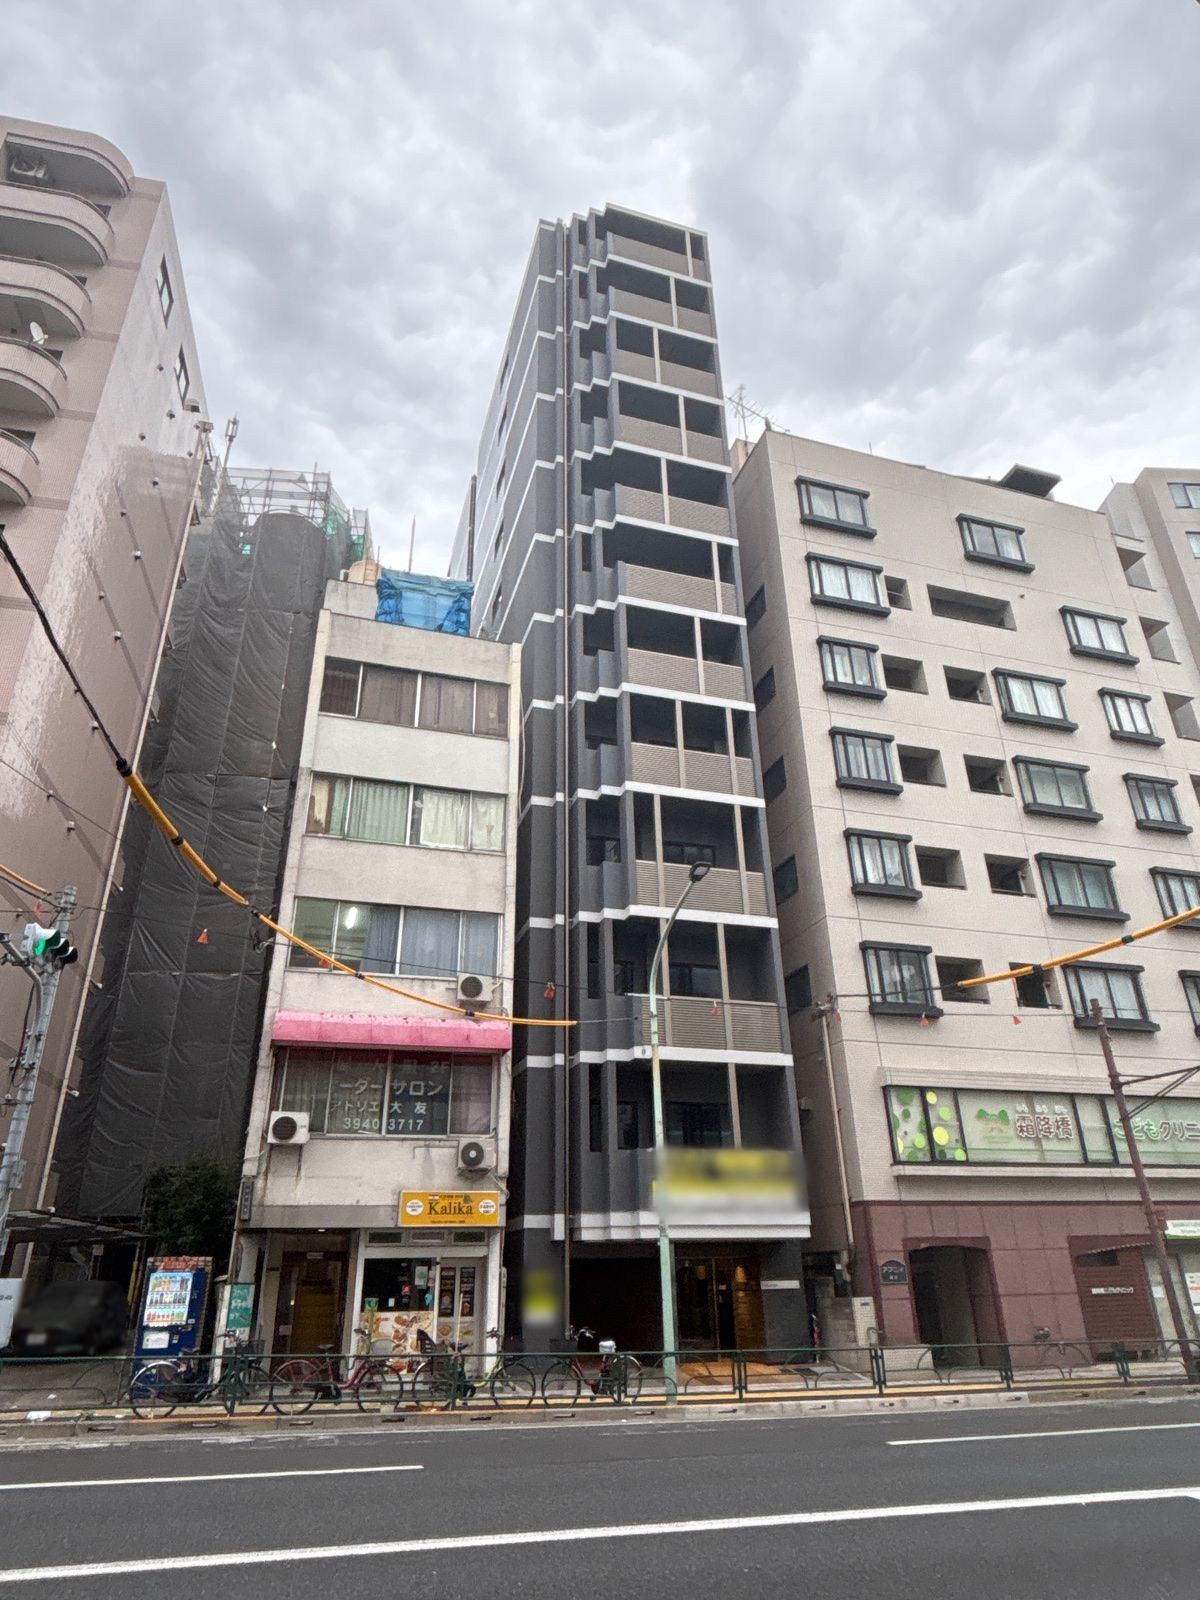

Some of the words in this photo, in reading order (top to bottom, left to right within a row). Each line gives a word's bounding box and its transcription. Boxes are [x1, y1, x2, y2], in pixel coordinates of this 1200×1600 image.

[343, 1117, 380, 1130] 3940
[388, 1119, 424, 1131] 3717
[1016, 1114, 1073, 1139] 霜降橋
[427, 1200, 473, 1215] Kalika
